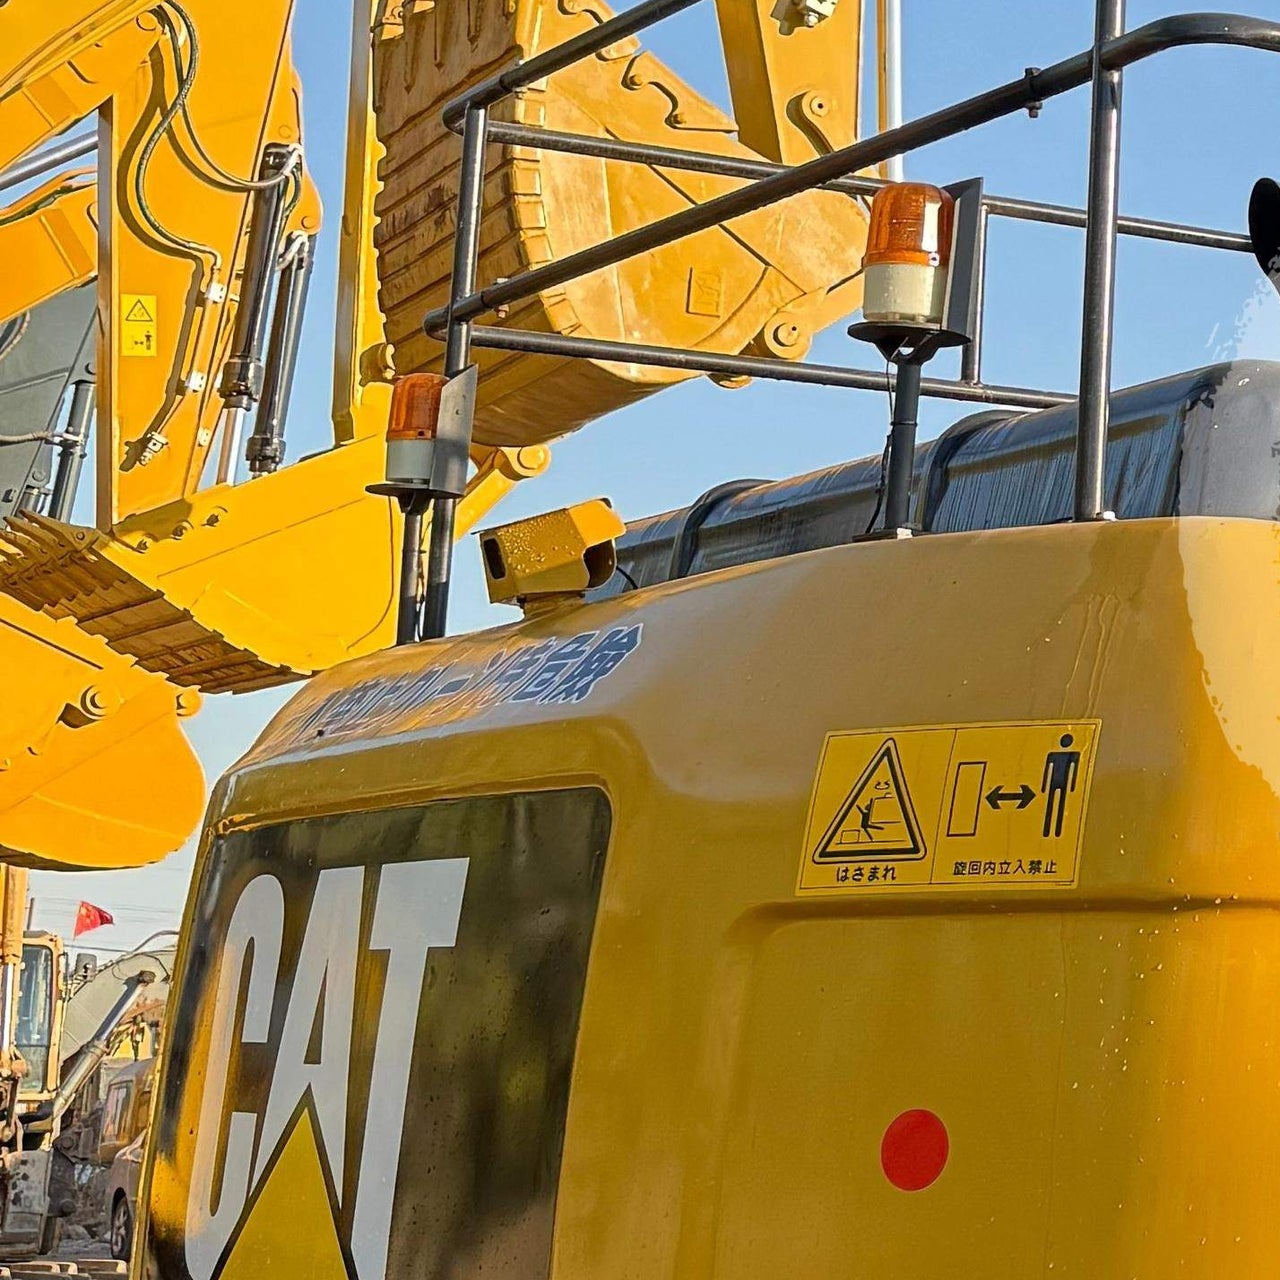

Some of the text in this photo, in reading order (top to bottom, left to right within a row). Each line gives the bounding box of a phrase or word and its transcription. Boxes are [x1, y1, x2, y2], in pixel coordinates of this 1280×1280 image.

[836, 865, 897, 883] はさまれ
[952, 858, 1058, 877] 旋回内立入禁止
